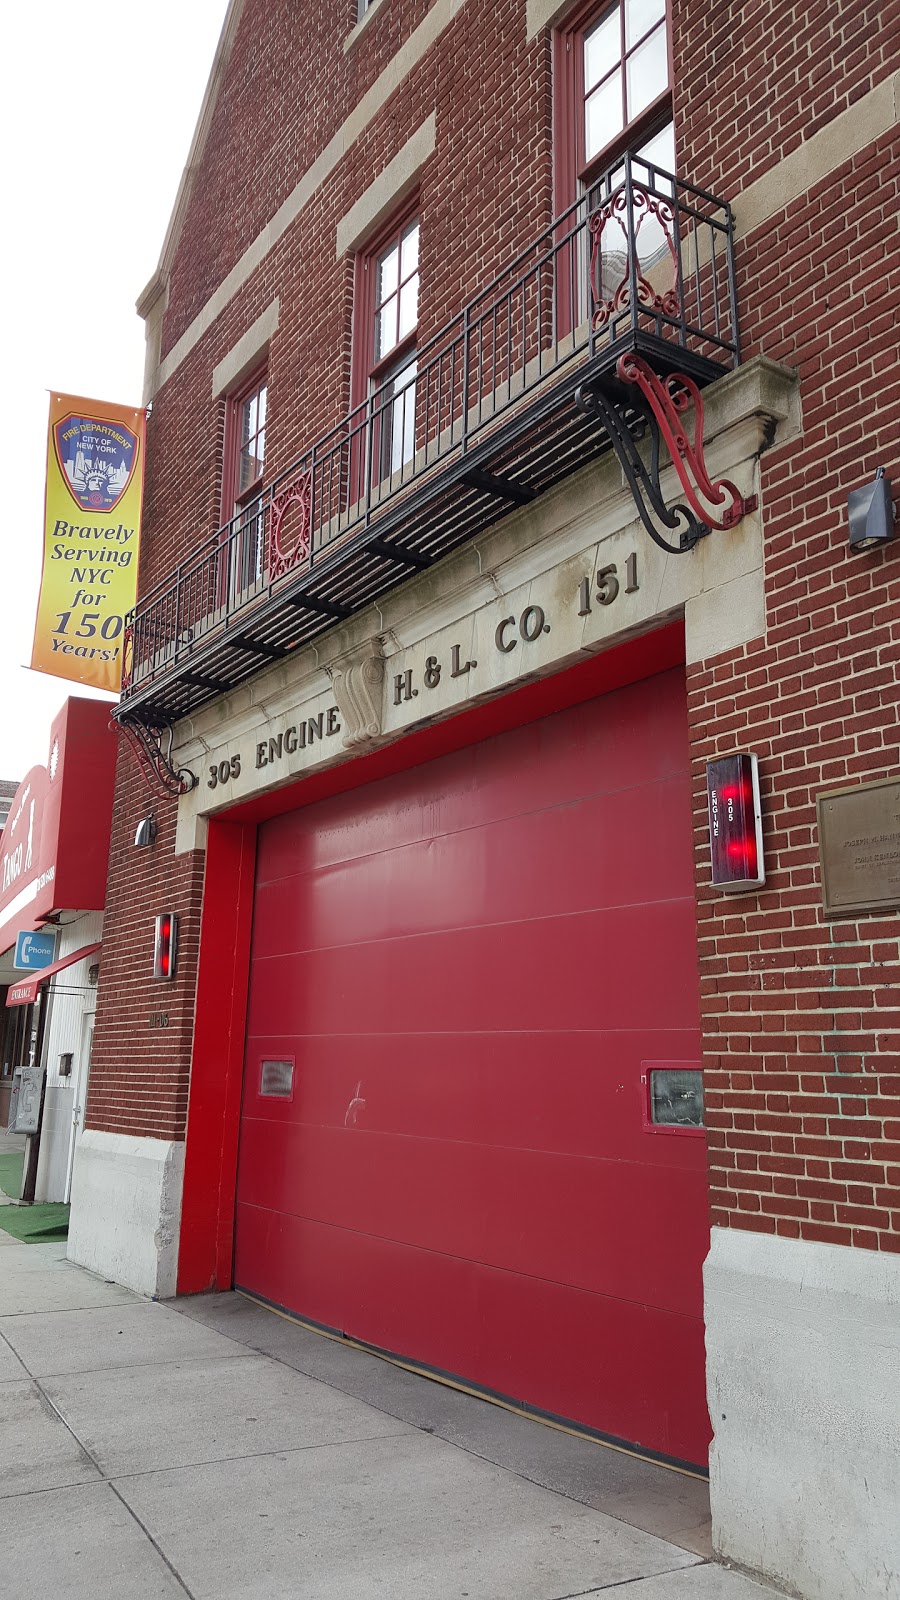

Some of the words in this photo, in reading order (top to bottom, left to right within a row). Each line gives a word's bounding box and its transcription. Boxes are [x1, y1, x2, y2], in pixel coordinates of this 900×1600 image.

[62, 426, 80, 441] FIRE
[80, 424, 132, 449] DEPARTMENT
[76, 441, 94, 451] NEW
[95, 444, 117, 454] YORK
[82, 435, 99, 444] CITY
[101, 438, 112, 446] OF
[52, 520, 134, 544] Bravely
[51, 543, 133, 567] Serving
[69, 567, 114, 585] NYC
[70, 589, 106, 608] for
[51, 611, 123, 640] 150
[51, 638, 120, 661] Years!
[207, 753, 241, 789] 305
[255, 705, 341, 769] ENGINE
[393, 669, 418, 706] H.
[424, 656, 441, 689] &
[450, 644, 477, 678] L.
[495, 605, 551, 653] CO.
[577, 552, 640, 617] 151
[711, 790, 719, 837] ENGINE
[2, 843, 23, 893] TANGO
[28, 946, 51, 955] Phone
